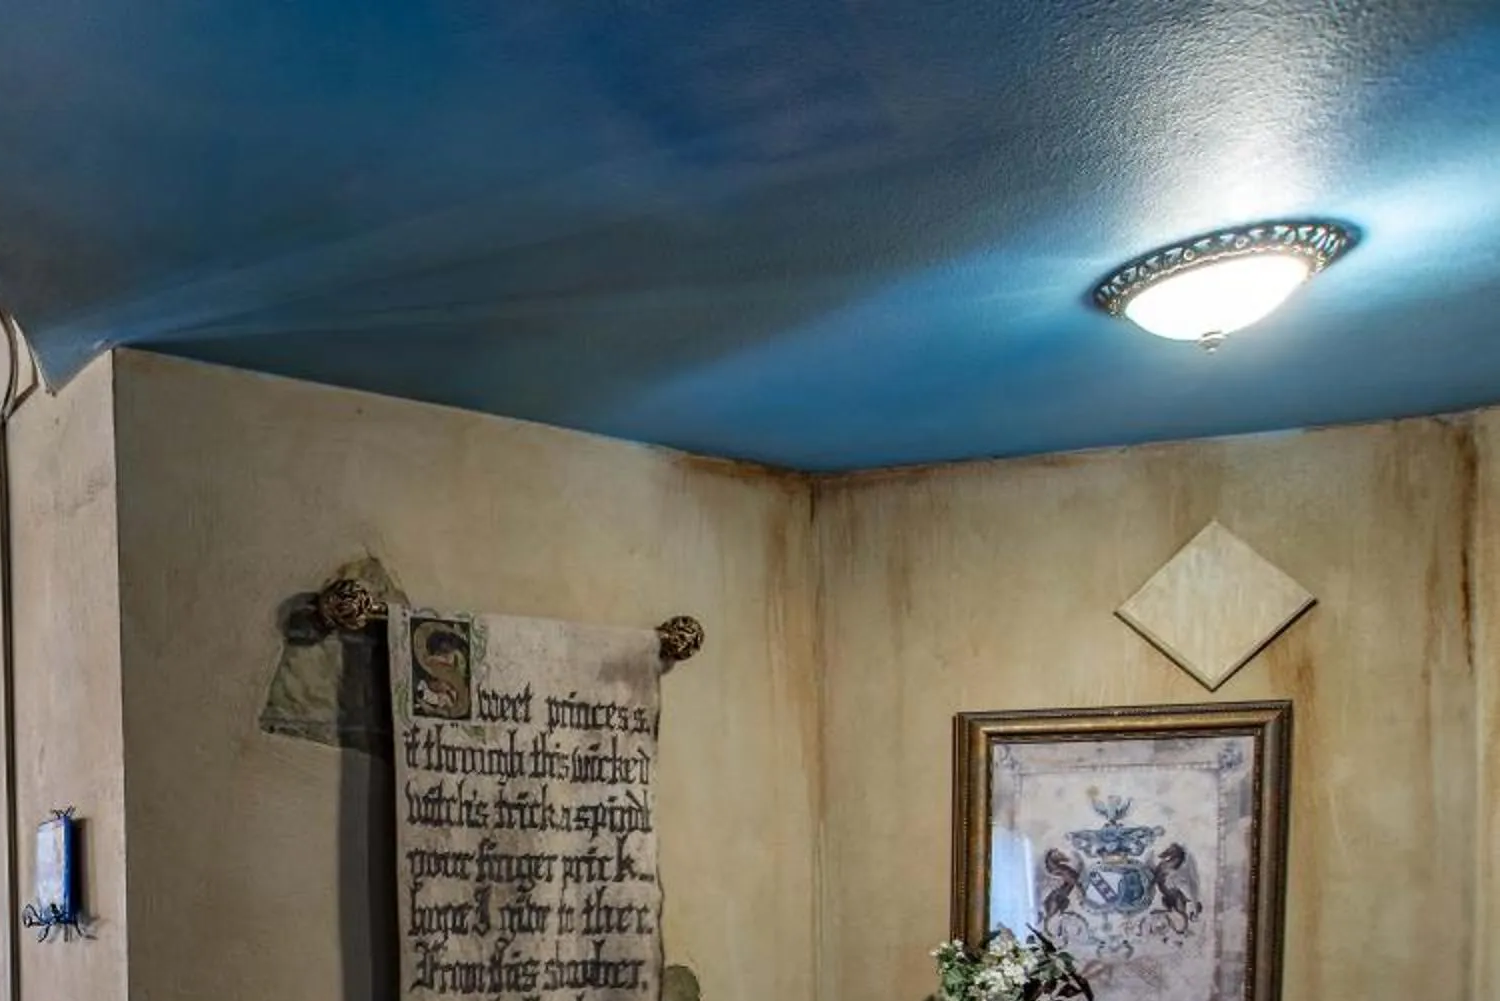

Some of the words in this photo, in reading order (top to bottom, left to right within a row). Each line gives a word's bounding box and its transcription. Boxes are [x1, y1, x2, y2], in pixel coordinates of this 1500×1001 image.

[423, 724, 525, 786] through
[529, 732, 569, 780] this
[570, 735, 650, 785] wicked
[406, 848, 474, 888] your
[476, 838, 558, 893] finger
[408, 883, 474, 941] hope
[471, 884, 492, 937] I
[496, 894, 550, 945] give
